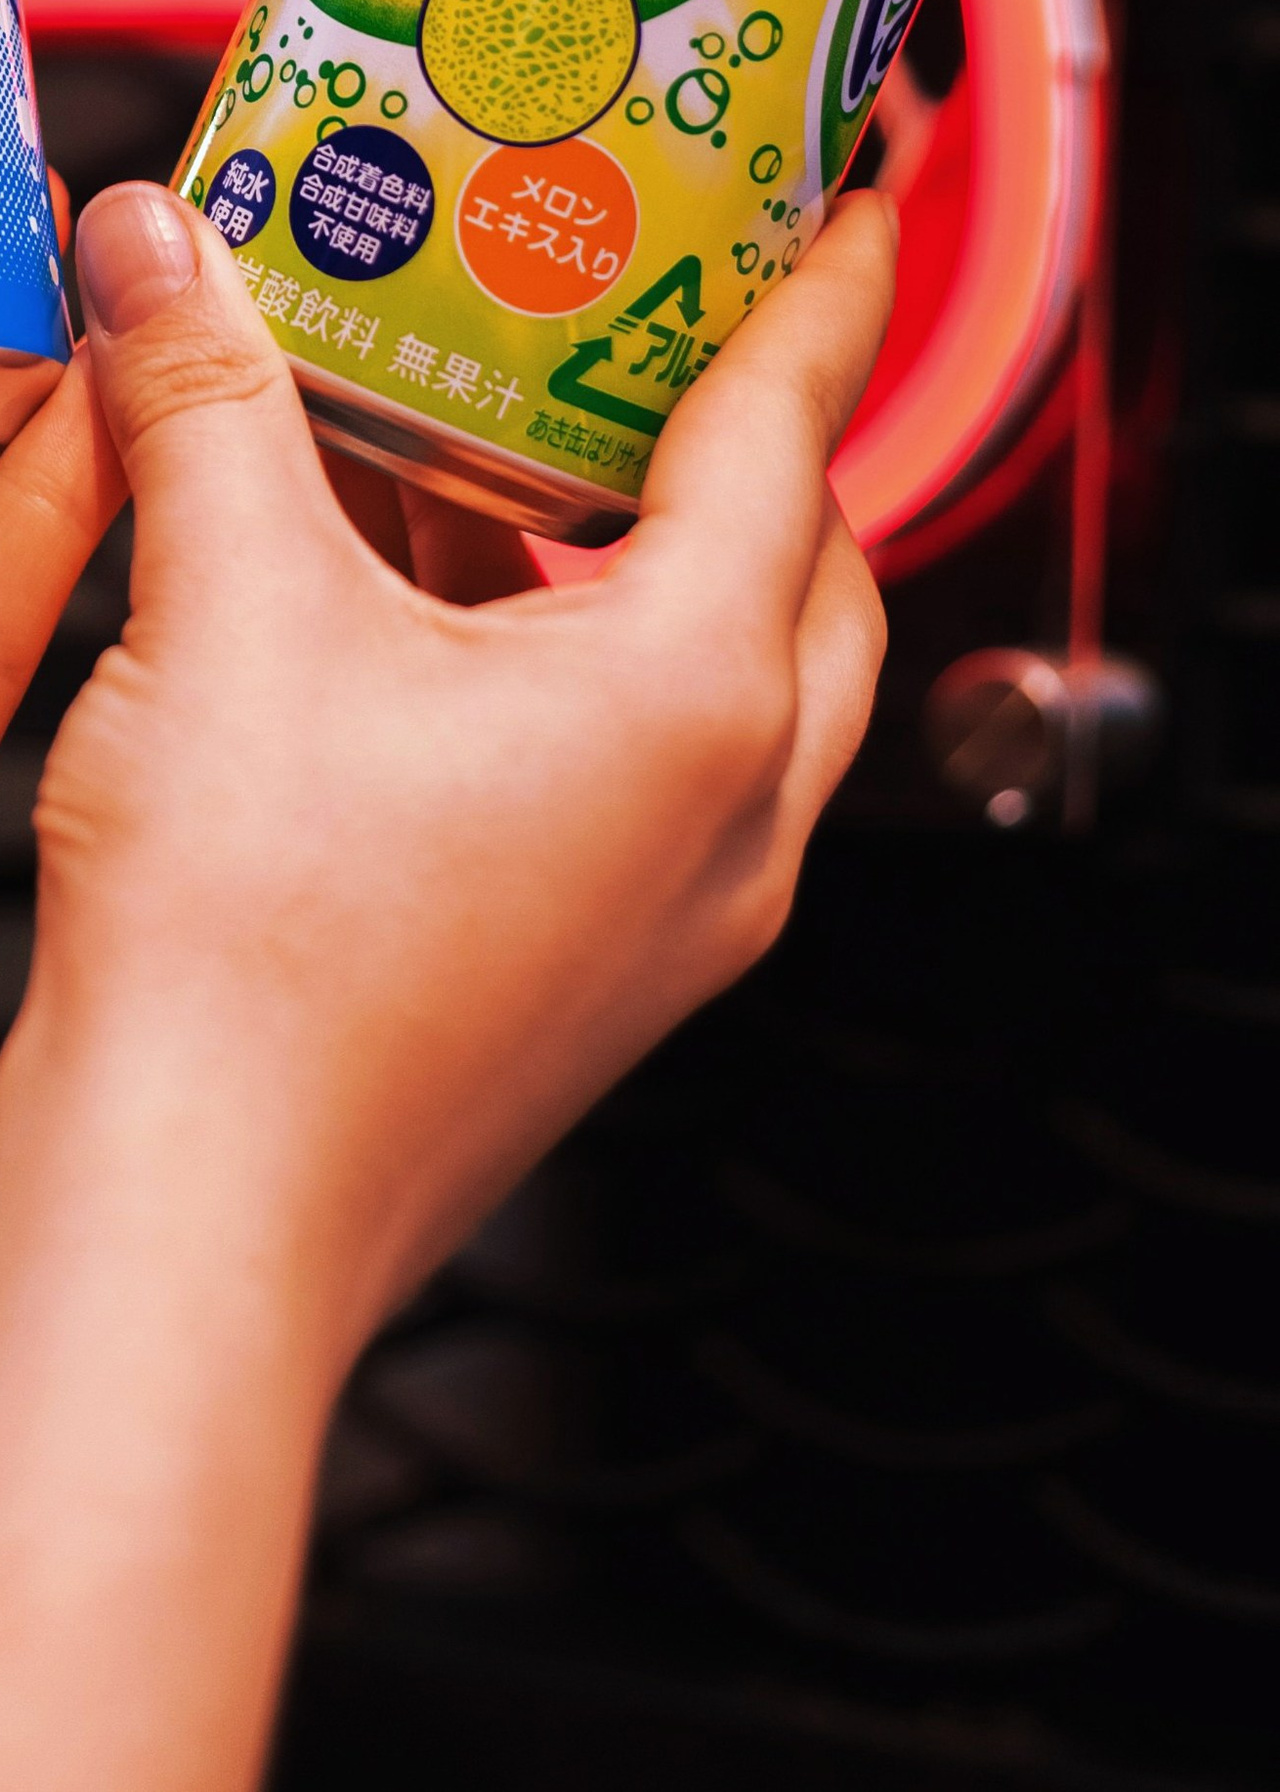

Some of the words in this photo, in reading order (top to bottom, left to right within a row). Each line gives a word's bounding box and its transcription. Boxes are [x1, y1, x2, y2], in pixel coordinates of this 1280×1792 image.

[222, 158, 269, 203] 純水
[299, 173, 419, 246] 合成甘味料
[312, 143, 431, 215] 合成着色料
[511, 174, 608, 226] メロン
[210, 195, 254, 242] 使用
[308, 211, 382, 265] 不使用
[464, 196, 619, 281] エキス入り
[386, 331, 524, 421] 無果汁
